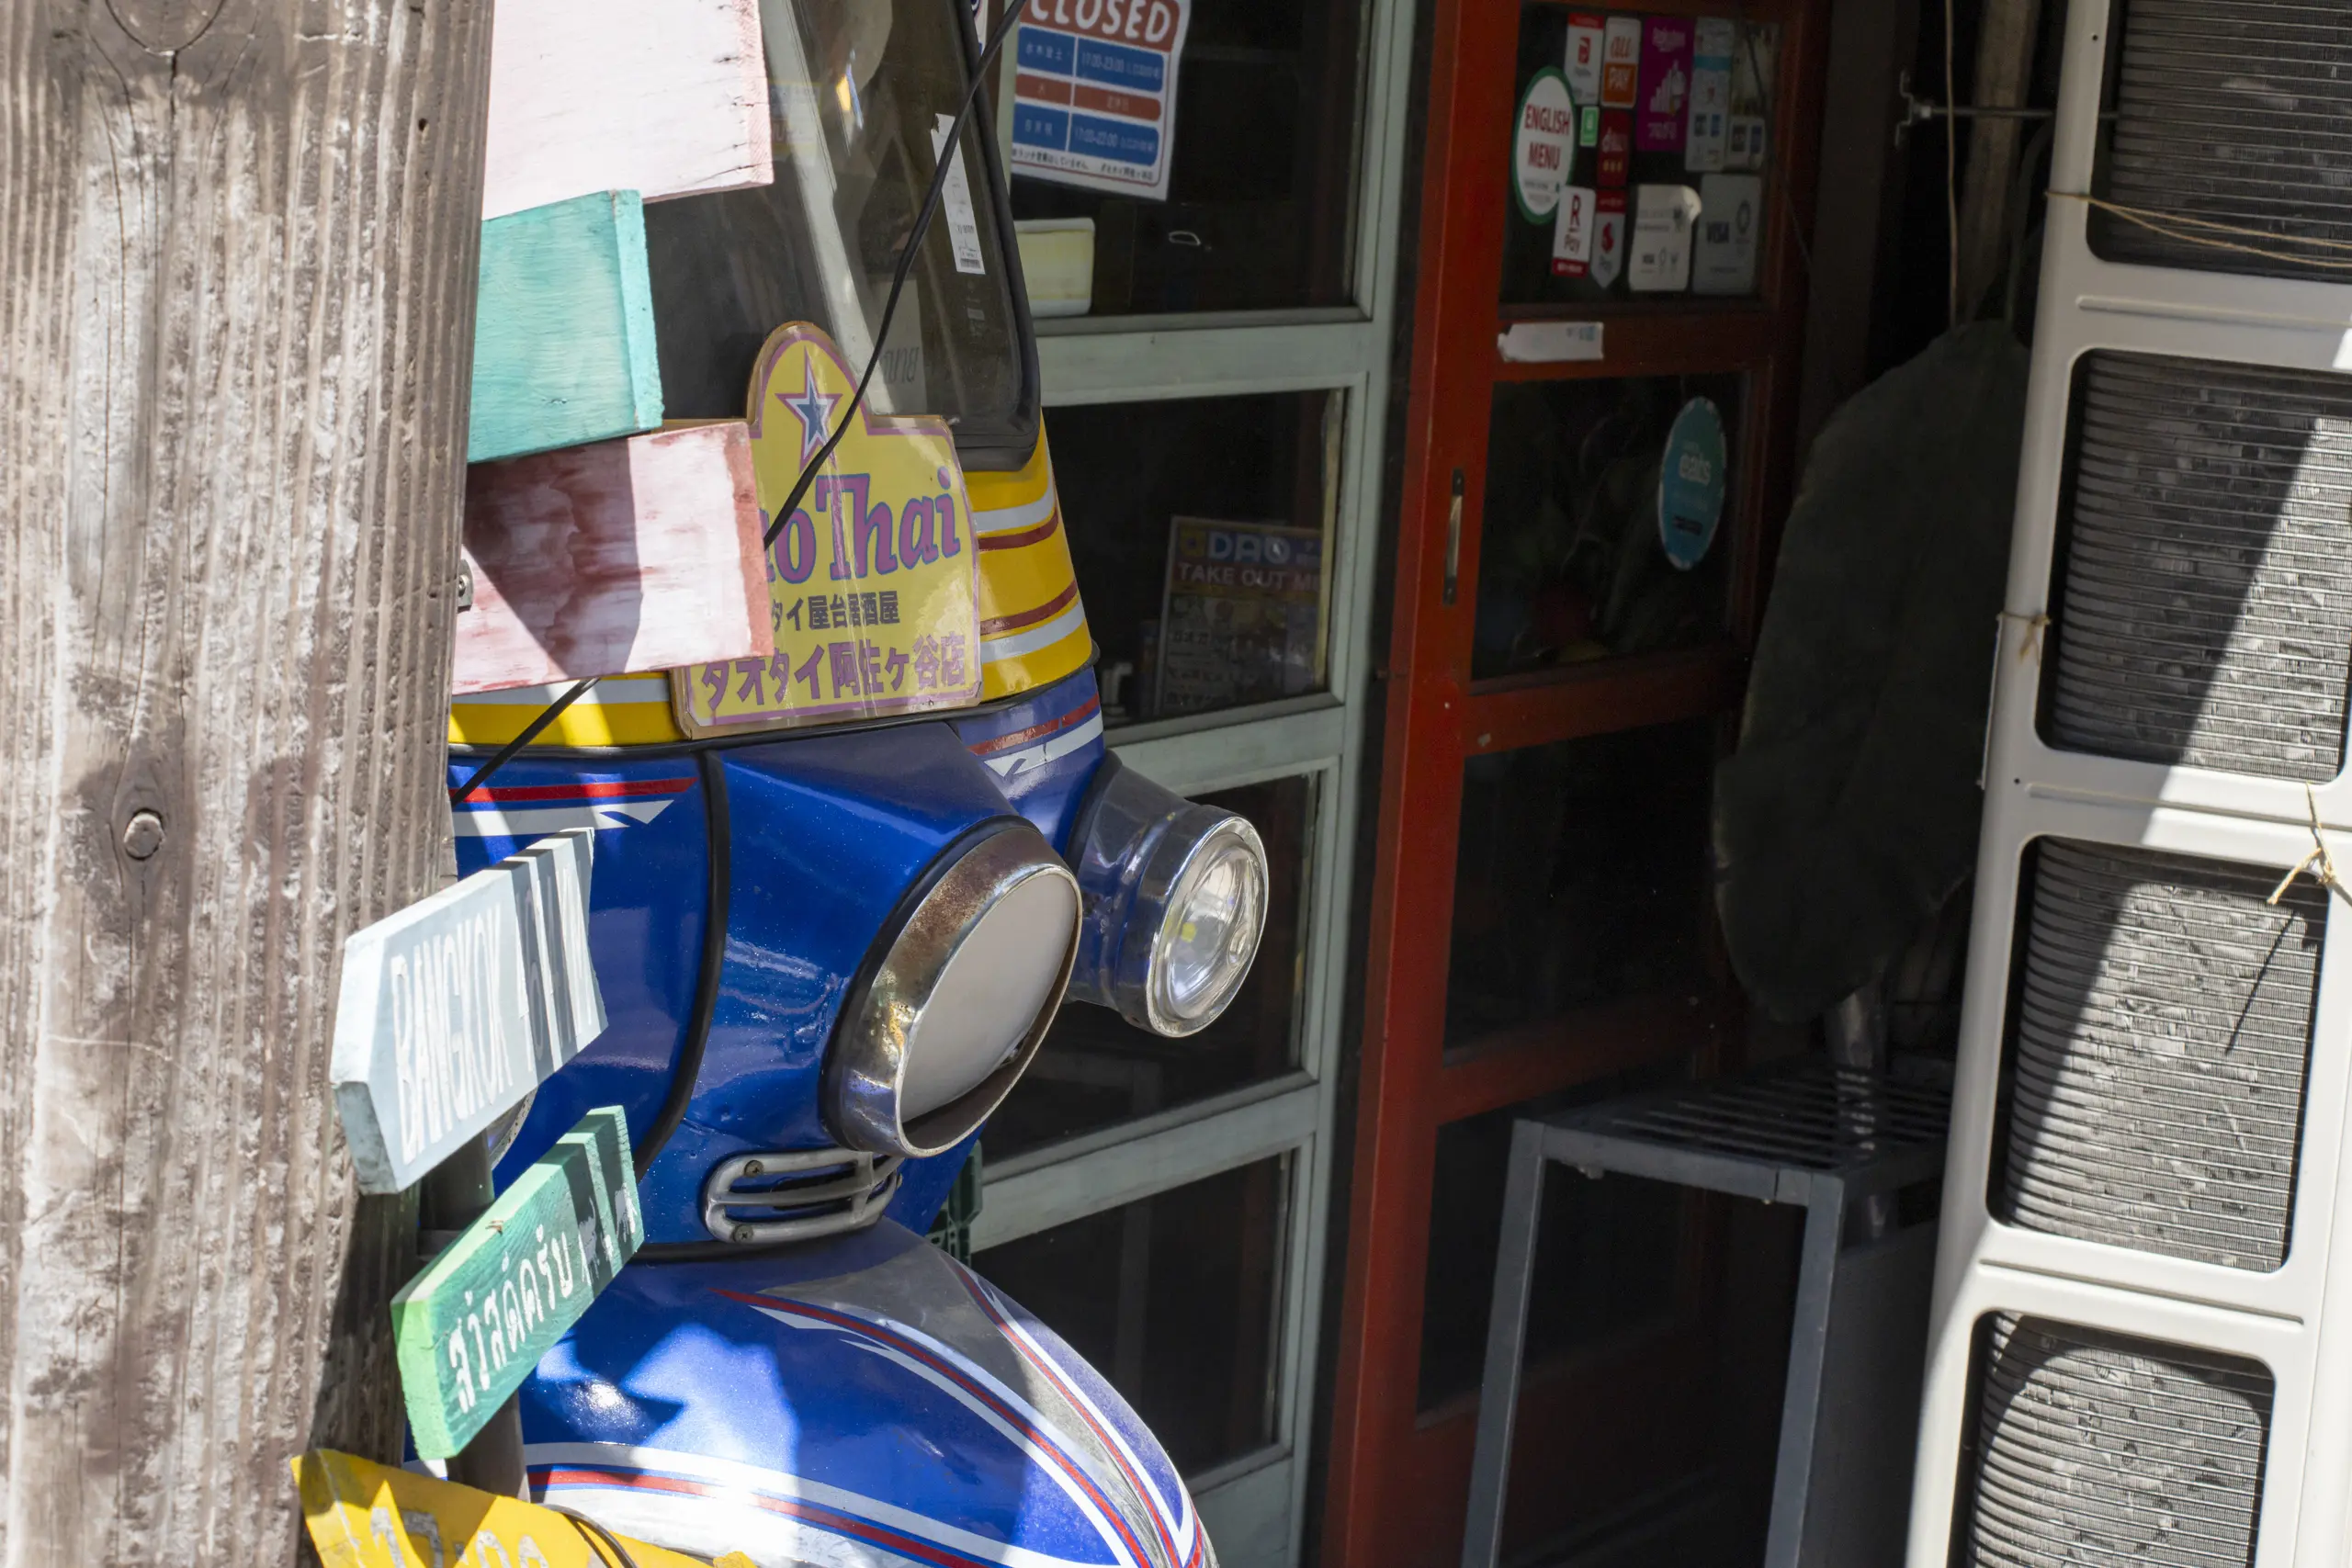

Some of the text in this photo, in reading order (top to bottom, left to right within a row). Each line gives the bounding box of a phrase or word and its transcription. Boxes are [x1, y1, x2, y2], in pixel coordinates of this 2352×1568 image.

[1524, 103, 1571, 137] ENGLISH
[1528, 141, 1561, 172] MENU
[1569, 194, 1582, 228] R
[1564, 233, 1581, 255] Pay
[1178, 561, 1236, 585] TAKE
[1241, 568, 1288, 591] OUT
[390, 902, 514, 1166] BANGKOK
